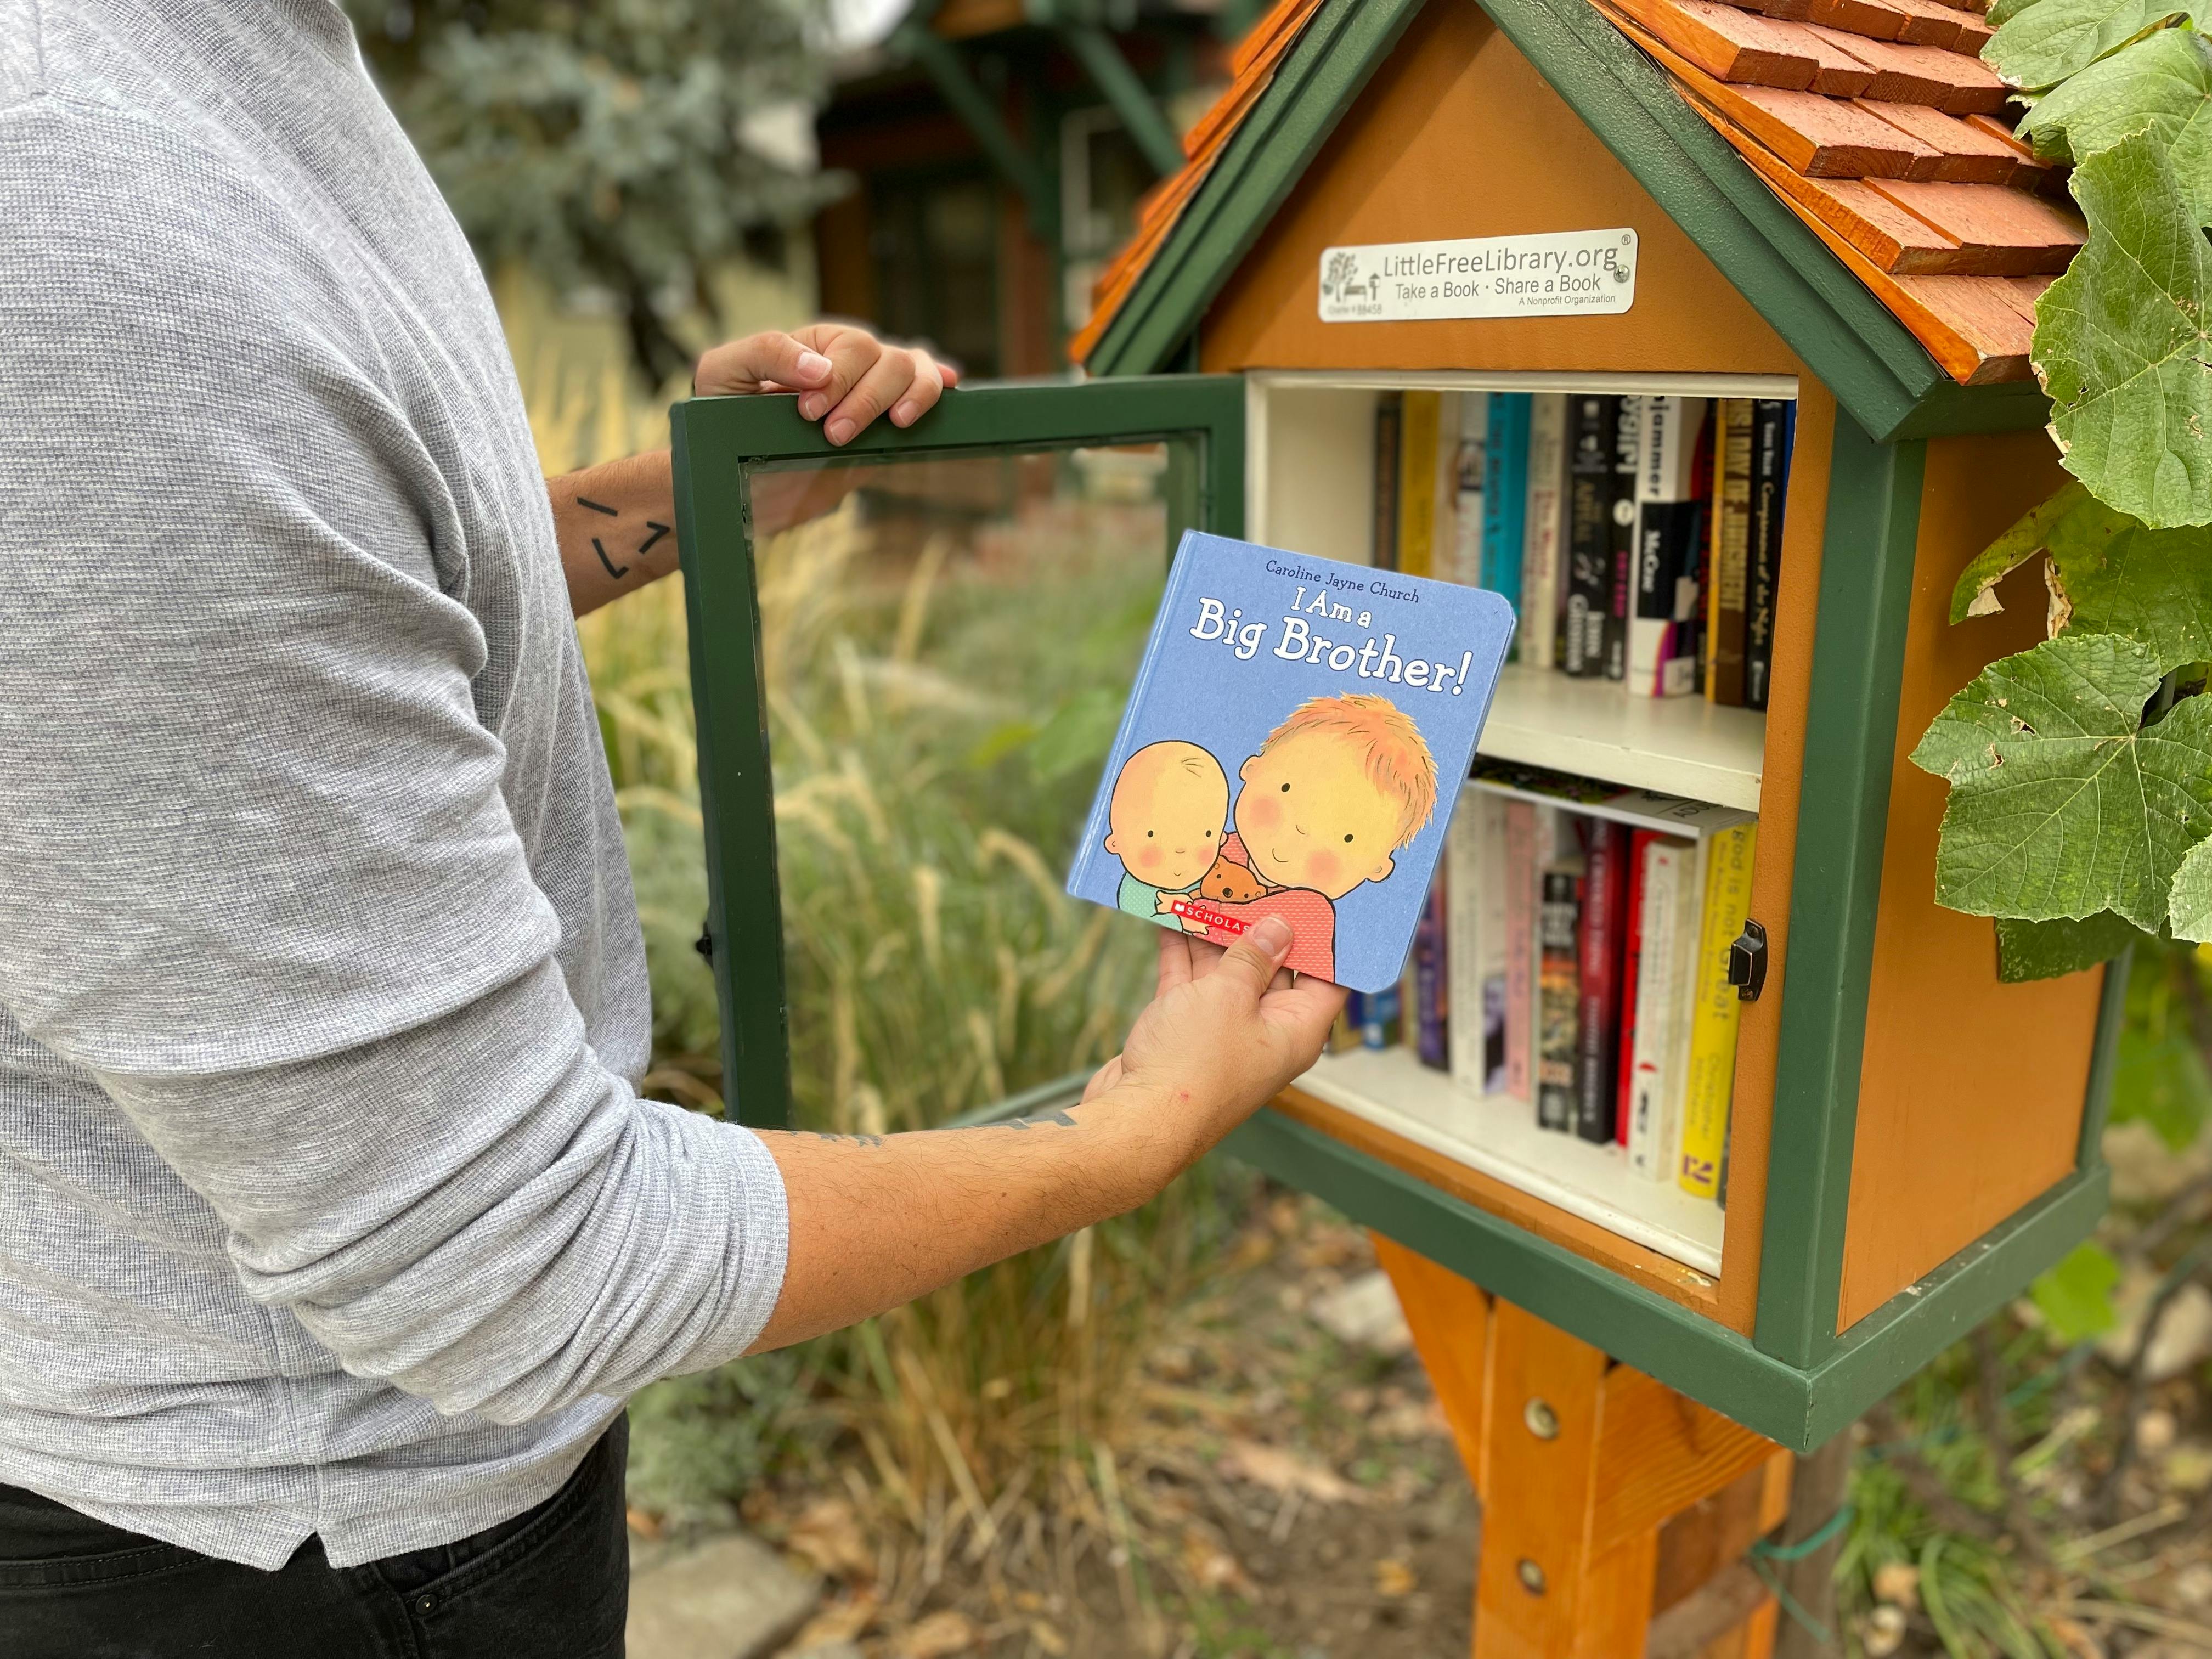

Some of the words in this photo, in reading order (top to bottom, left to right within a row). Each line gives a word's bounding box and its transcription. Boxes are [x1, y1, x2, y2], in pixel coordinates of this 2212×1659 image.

[1384, 247, 1618, 276] LittleFreeLibrary.org
[1395, 283, 1426, 299] Take
[1431, 287, 1438, 298] a
[1443, 280, 1480, 298] Book
[1494, 277, 1539, 295] Share
[1544, 279, 1554, 292] a
[1560, 273, 1601, 292] Book
[1519, 297, 1525, 306] A
[1527, 295, 1562, 307] Nonprofit
[1564, 294, 1616, 306] Organization
[1266, 560, 1321, 583] Caroline
[1325, 572, 1364, 591] Jayne
[1370, 581, 1420, 603] Church
[1290, 585, 1307, 611] I
[1304, 589, 1353, 623] Am
[1356, 610, 1373, 629] a
[1189, 596, 1268, 661] Big
[1273, 616, 1474, 696] Brother!
[1186, 907, 1251, 934] SCHOLAS
